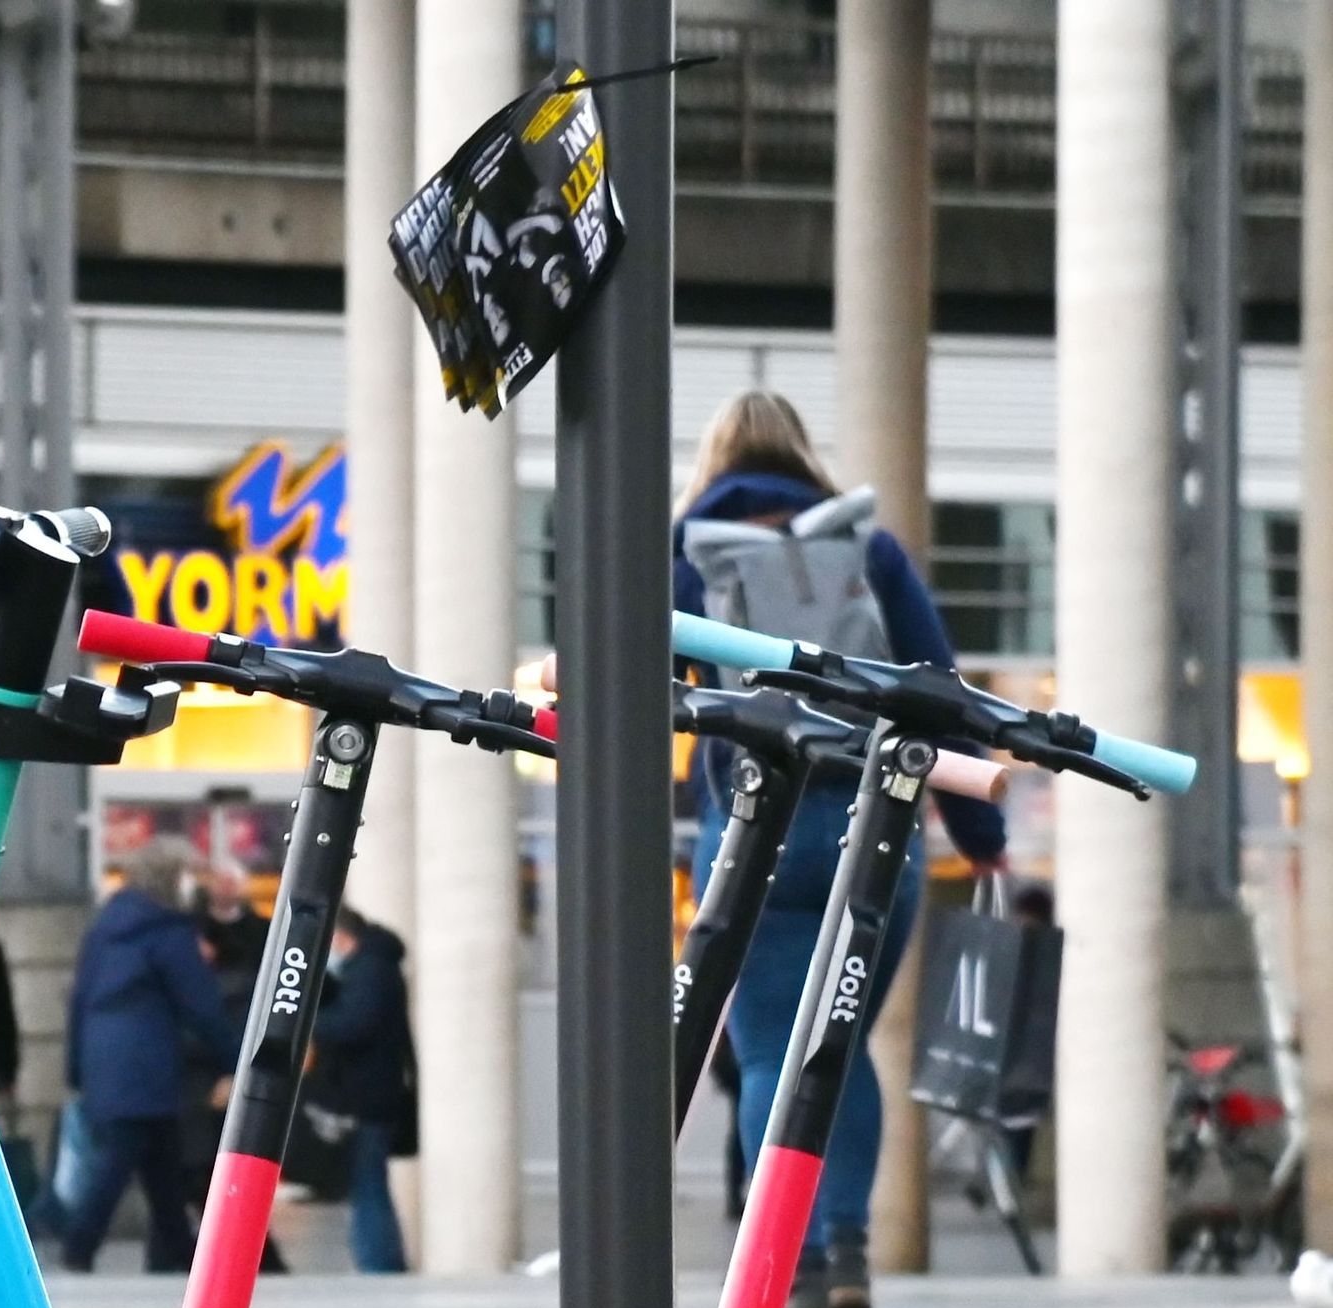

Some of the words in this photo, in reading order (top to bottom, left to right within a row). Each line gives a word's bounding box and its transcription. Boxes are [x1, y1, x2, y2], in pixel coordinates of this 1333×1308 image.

[117, 552, 348, 642] YORM
[272, 947, 308, 1014] dott
[673, 964, 693, 1024] do
[831, 955, 867, 1023] dott
